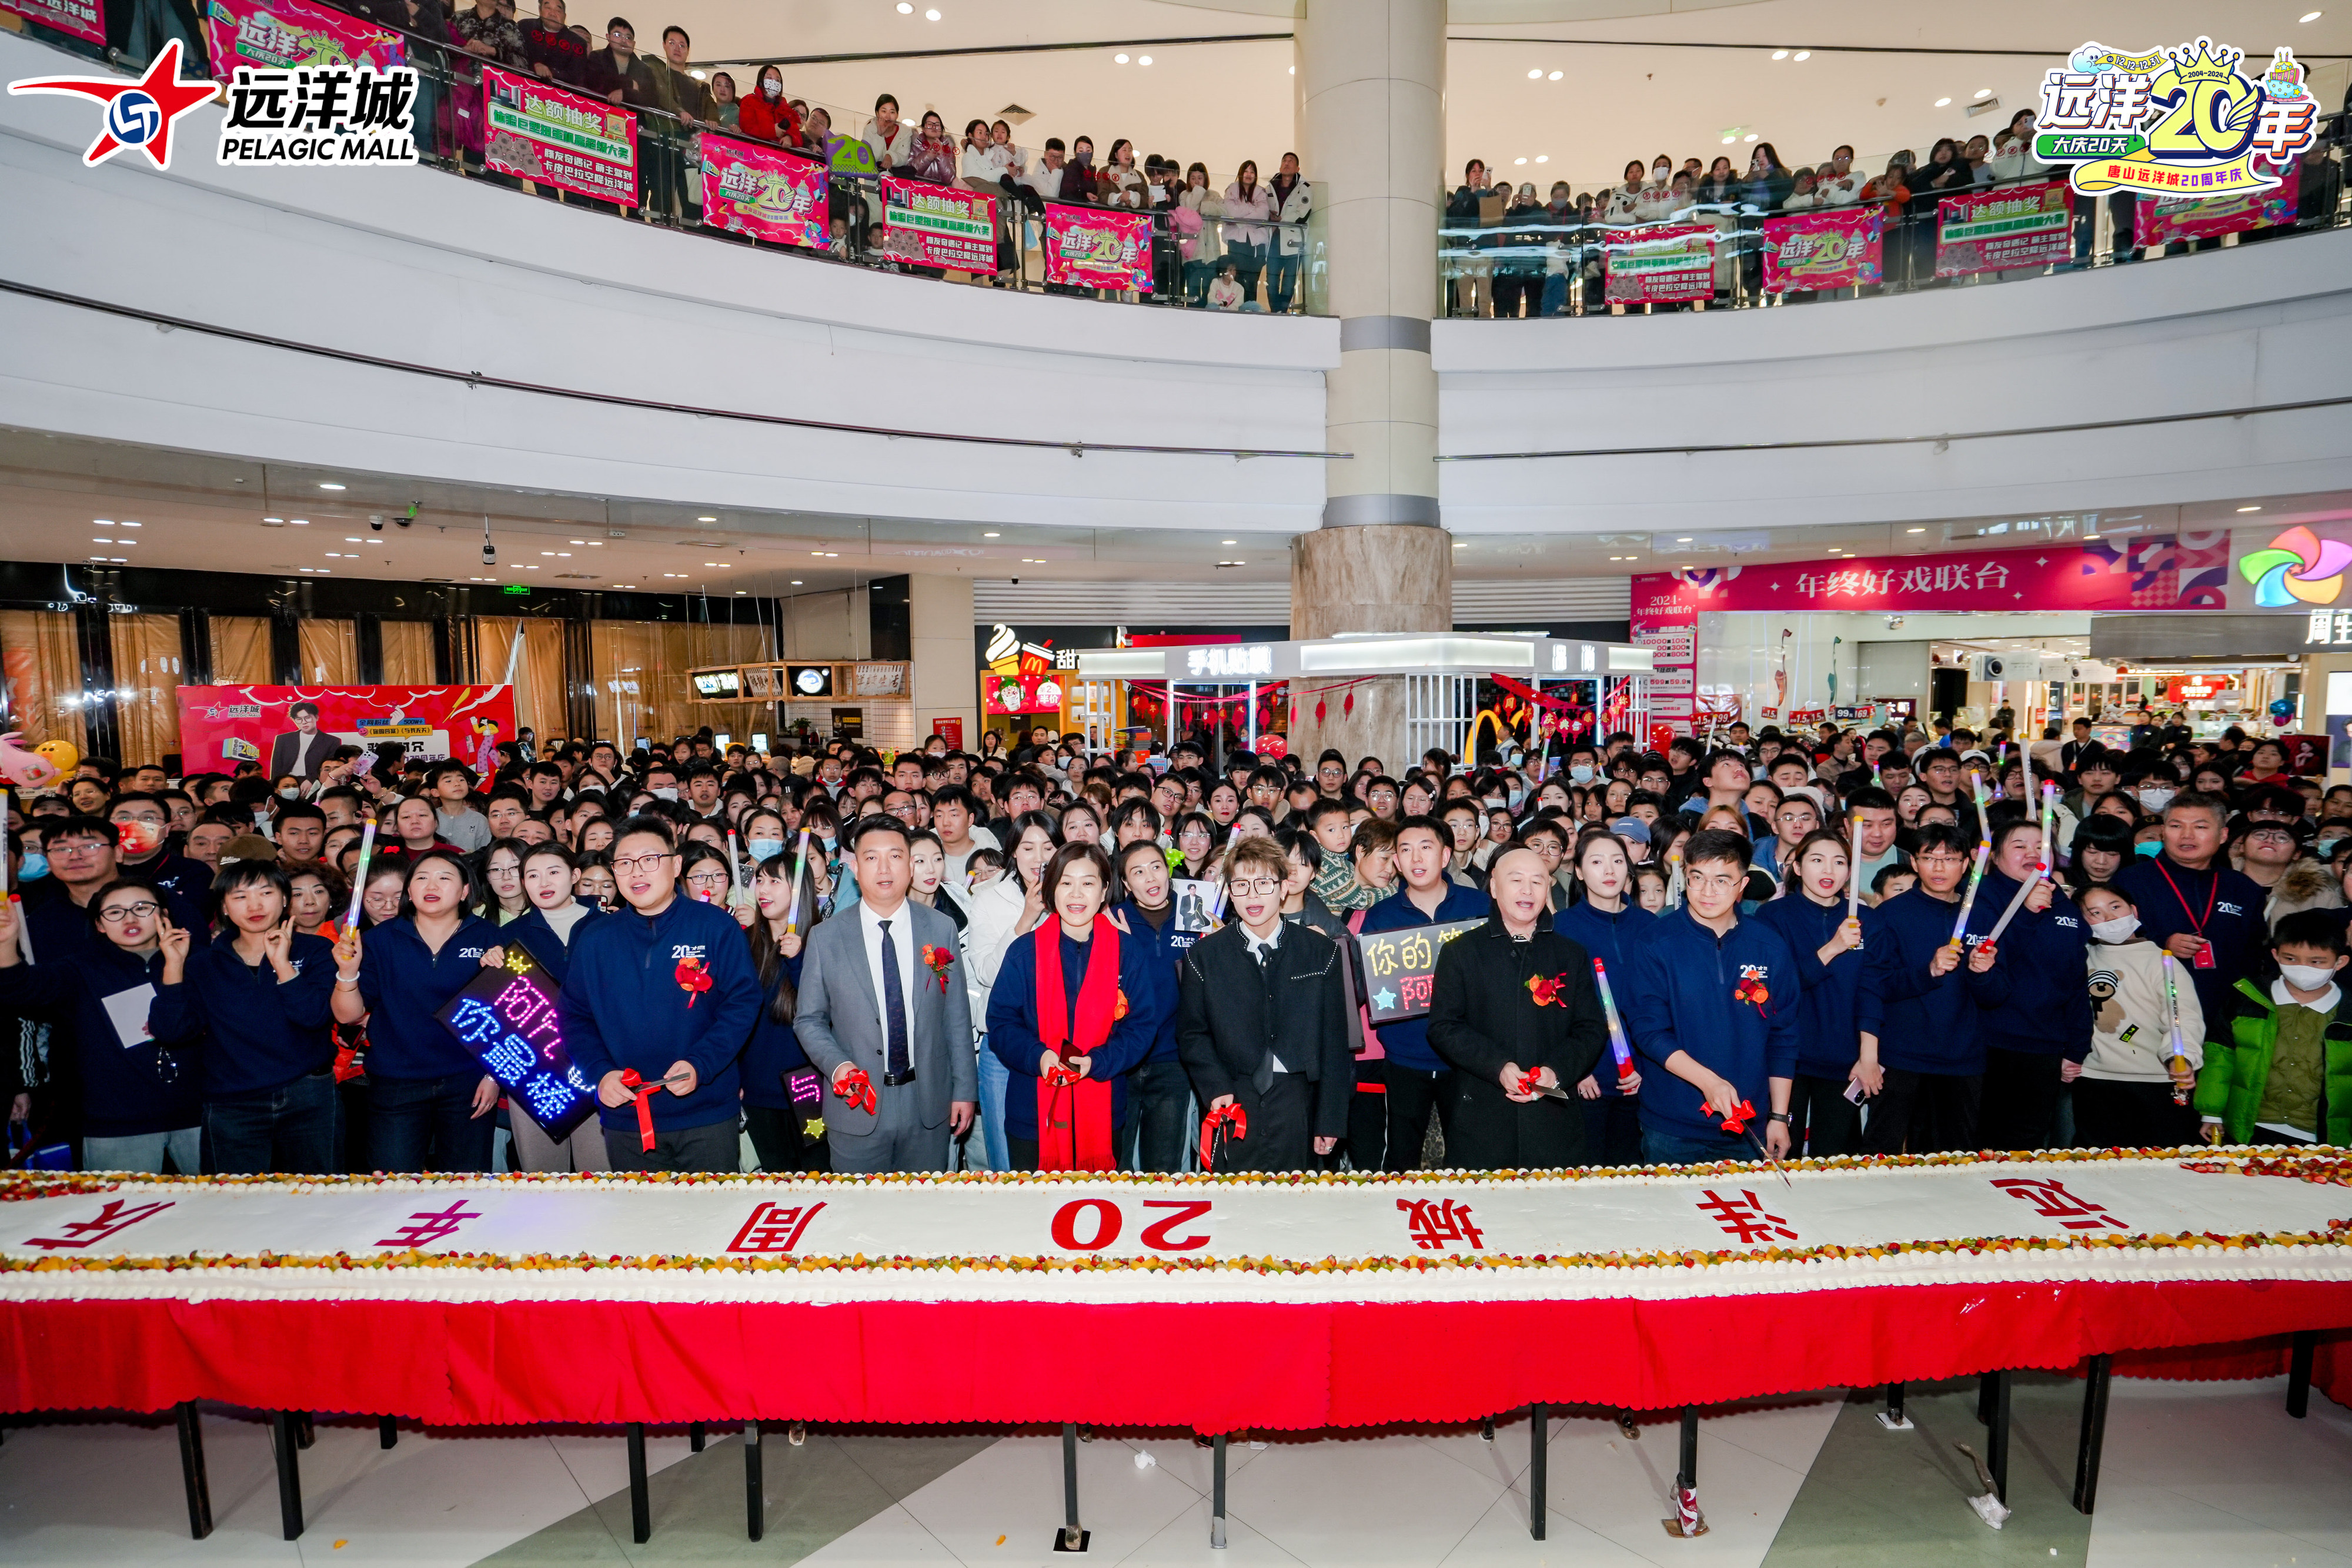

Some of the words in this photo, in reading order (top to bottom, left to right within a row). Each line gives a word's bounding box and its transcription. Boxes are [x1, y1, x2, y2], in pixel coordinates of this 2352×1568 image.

[246, 48, 288, 68] 大庆20天
[524, 92, 603, 133] 达额抽奖
[543, 161, 634, 193] 卡皮巴拉空降远洋城
[724, 190, 751, 202] 大庆20天
[911, 192, 970, 216] 达额抽奖
[1971, 196, 2041, 219] 达额抽奖
[926, 247, 994, 263] 卡皮巴拉空降远洋城
[1795, 561, 2010, 599] 年终好戏联台
[1651, 595, 1676, 606] 2024
[1636, 605, 1692, 616] 年终好戏联台
[1188, 646, 1272, 676] 手机贴膜
[1040, 694, 1058, 704] 半价
[1619, 696, 1628, 706] 你
[1544, 713, 1555, 725] 庆
[1559, 719, 1569, 730] 典
[2217, 901, 2231, 912] 20
[2054, 916, 2069, 927] 20
[1171, 935, 1183, 947] 20
[1966, 933, 1978, 946] 20
[459, 948, 477, 958] 20
[671, 945, 690, 958] 20
[452, 998, 576, 1118] 你最棒
